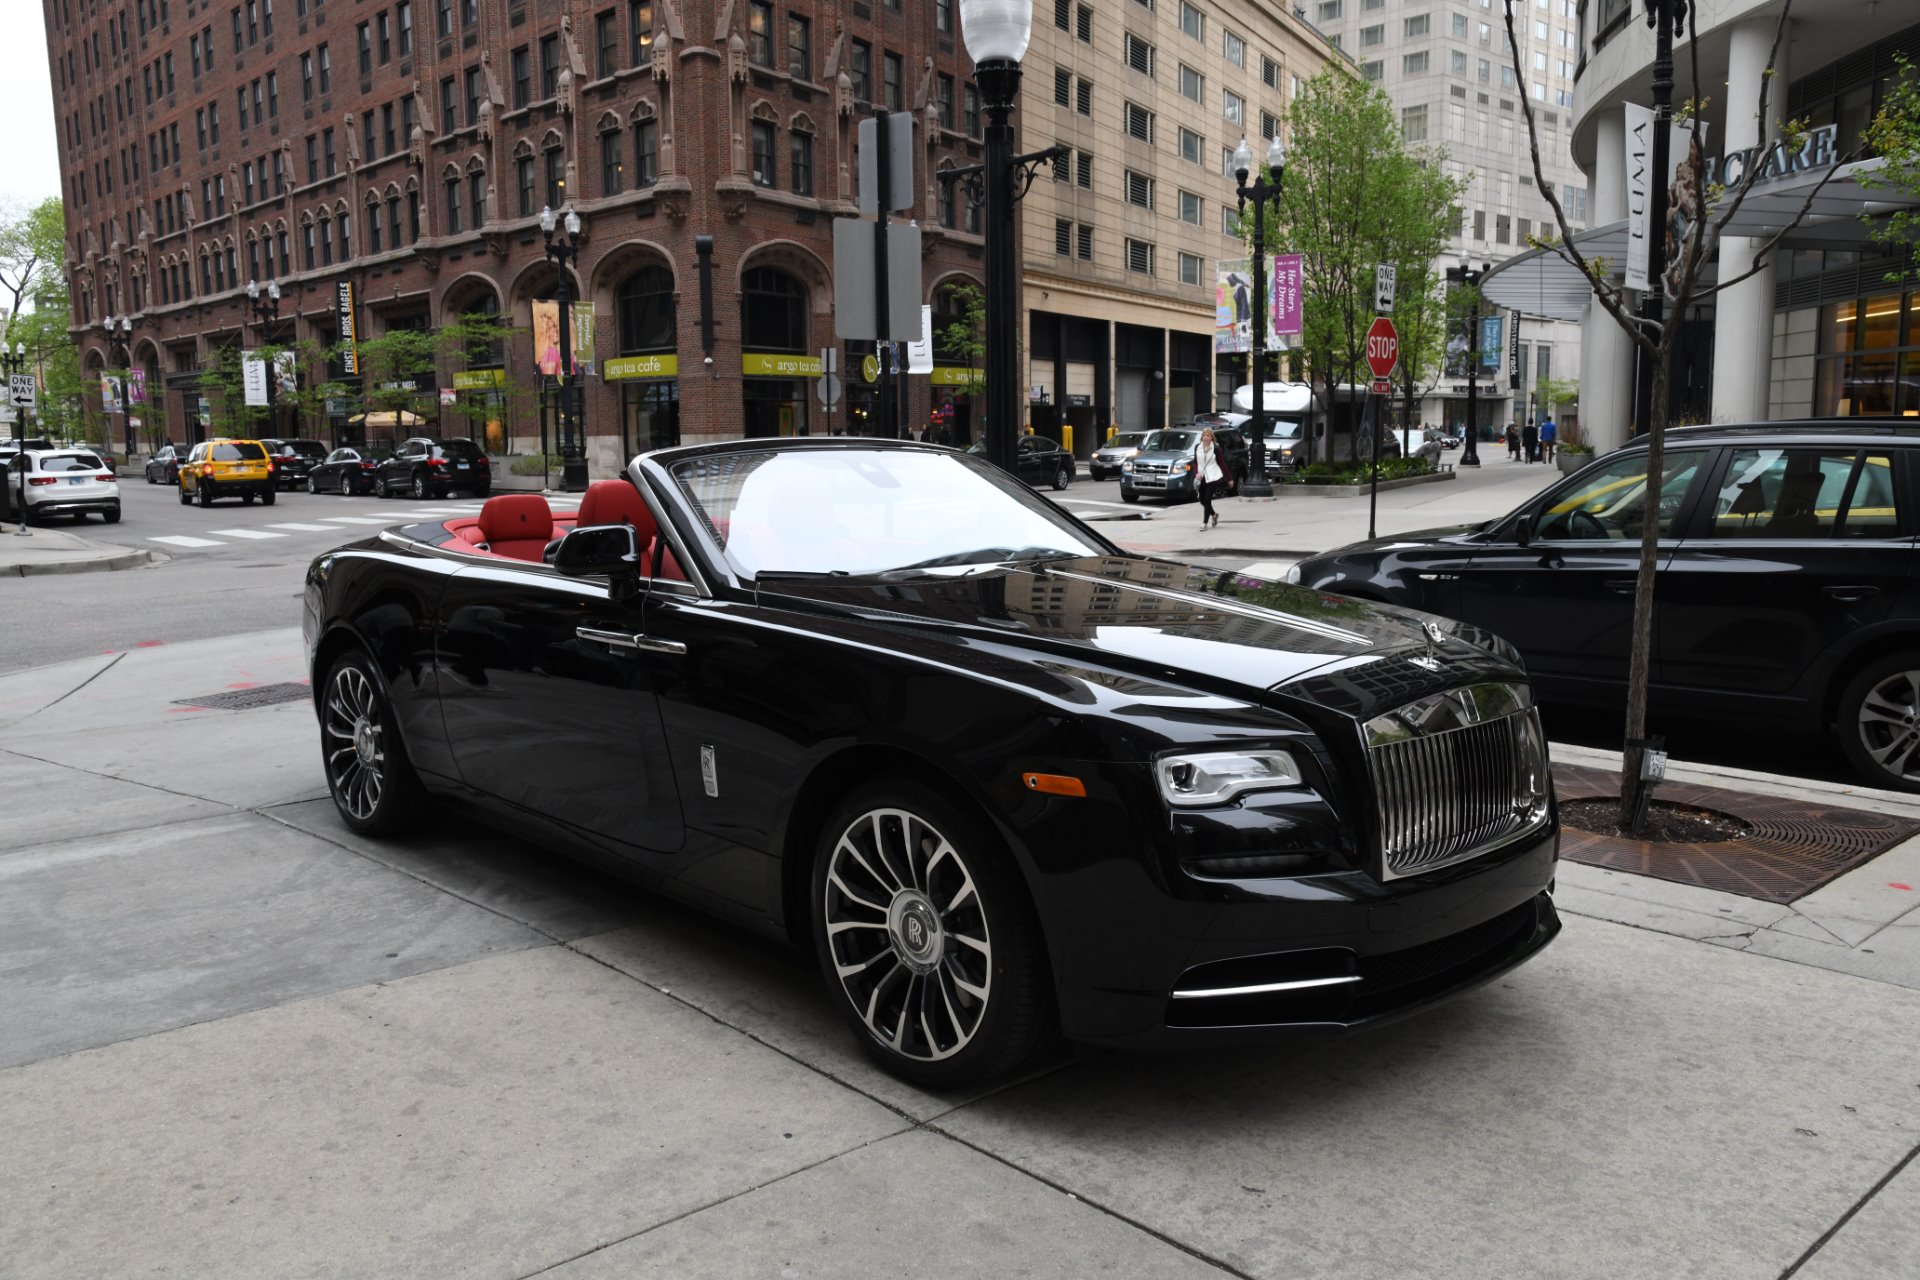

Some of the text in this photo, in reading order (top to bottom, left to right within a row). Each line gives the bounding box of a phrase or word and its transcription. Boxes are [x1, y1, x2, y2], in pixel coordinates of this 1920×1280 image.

[1631, 122, 1647, 239] LUMA
[1287, 269, 1297, 287] Her
[1379, 267, 1394, 281] ONE
[339, 282, 351, 313] BAGELS
[1276, 270, 1287, 320] My Dreams
[1378, 281, 1393, 293] WAY
[1286, 288, 1297, 313] Story,
[1368, 335, 1396, 359] STOP
[1510, 311, 1519, 376] ORDSTROM rack
[342, 338, 355, 373] EINSTN
[624, 362, 636, 374] tea
[637, 356, 661, 373] café
[777, 361, 798, 374] argo
[799, 360, 809, 372] tea
[11, 386, 33, 395] WAY
[12, 376, 33, 386] ONE
